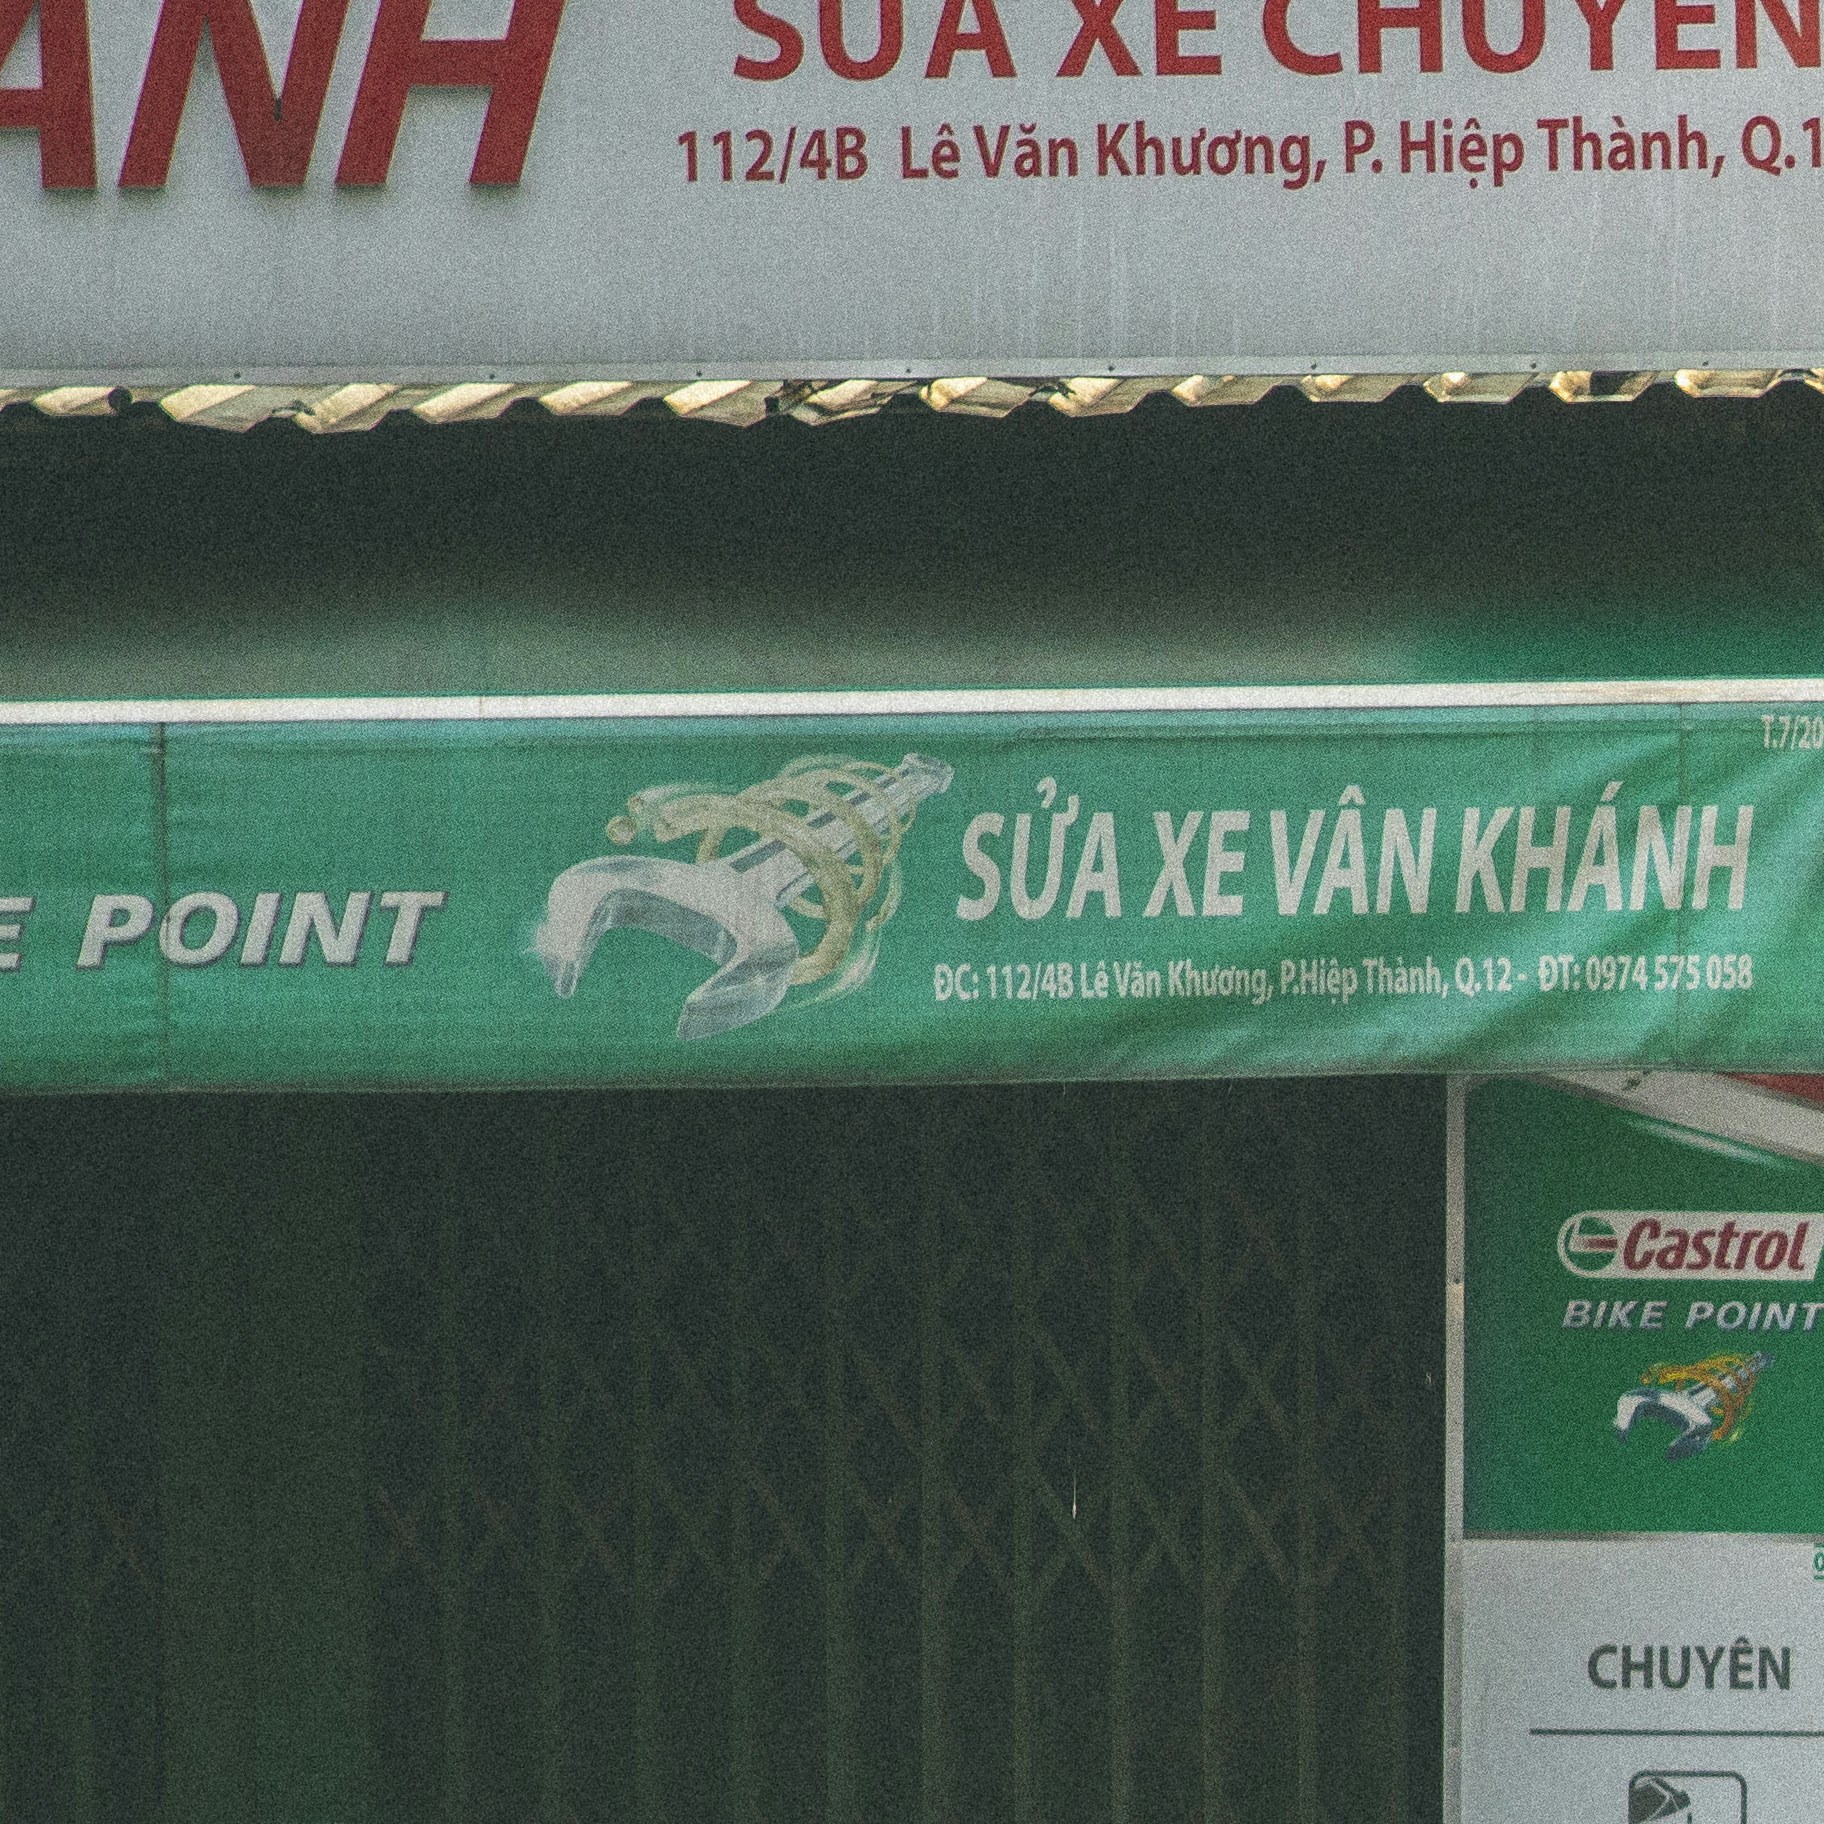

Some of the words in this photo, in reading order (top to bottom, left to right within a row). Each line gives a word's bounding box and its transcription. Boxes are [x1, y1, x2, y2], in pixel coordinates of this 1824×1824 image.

[1056, 0, 1223, 77] XE
[677, 125, 868, 184] 112/4B
[899, 126, 962, 180] Lê
[973, 121, 1078, 179] Văn
[1096, 120, 1329, 190] Khương,
[1342, 119, 1384, 174] P.
[1399, 118, 1526, 188] Hiệp
[1536, 114, 1727, 180] Thành,
[956, 776, 1123, 921] SỬA
[1143, 808, 1251, 918] XE
[1267, 785, 1439, 915] VÂN
[1455, 780, 1755, 914] KHÁNH
[76, 889, 448, 969] POINT
[934, 963, 980, 1001] ĐC:
[986, 961, 1074, 1001] 112/4B
[1080, 959, 1108, 999] Lê
[1114, 957, 1162, 999] Văn
[1168, 957, 1274, 1006] Khương,
[1280, 955, 1359, 1005] P.Hiệp
[1362, 953, 1449, 999] Thành,
[1455, 955, 1513, 998] Q.12
[1538, 953, 1581, 993] ĐT:
[1585, 953, 1648, 992] 0974
[1653, 953, 1700, 991] 575
[1706, 953, 1754, 991] 058
[1621, 1217, 1810, 1273] Castrol
[1562, 1298, 1669, 1334] BIKE
[1586, 1636, 1793, 1692] CHUYÊN
